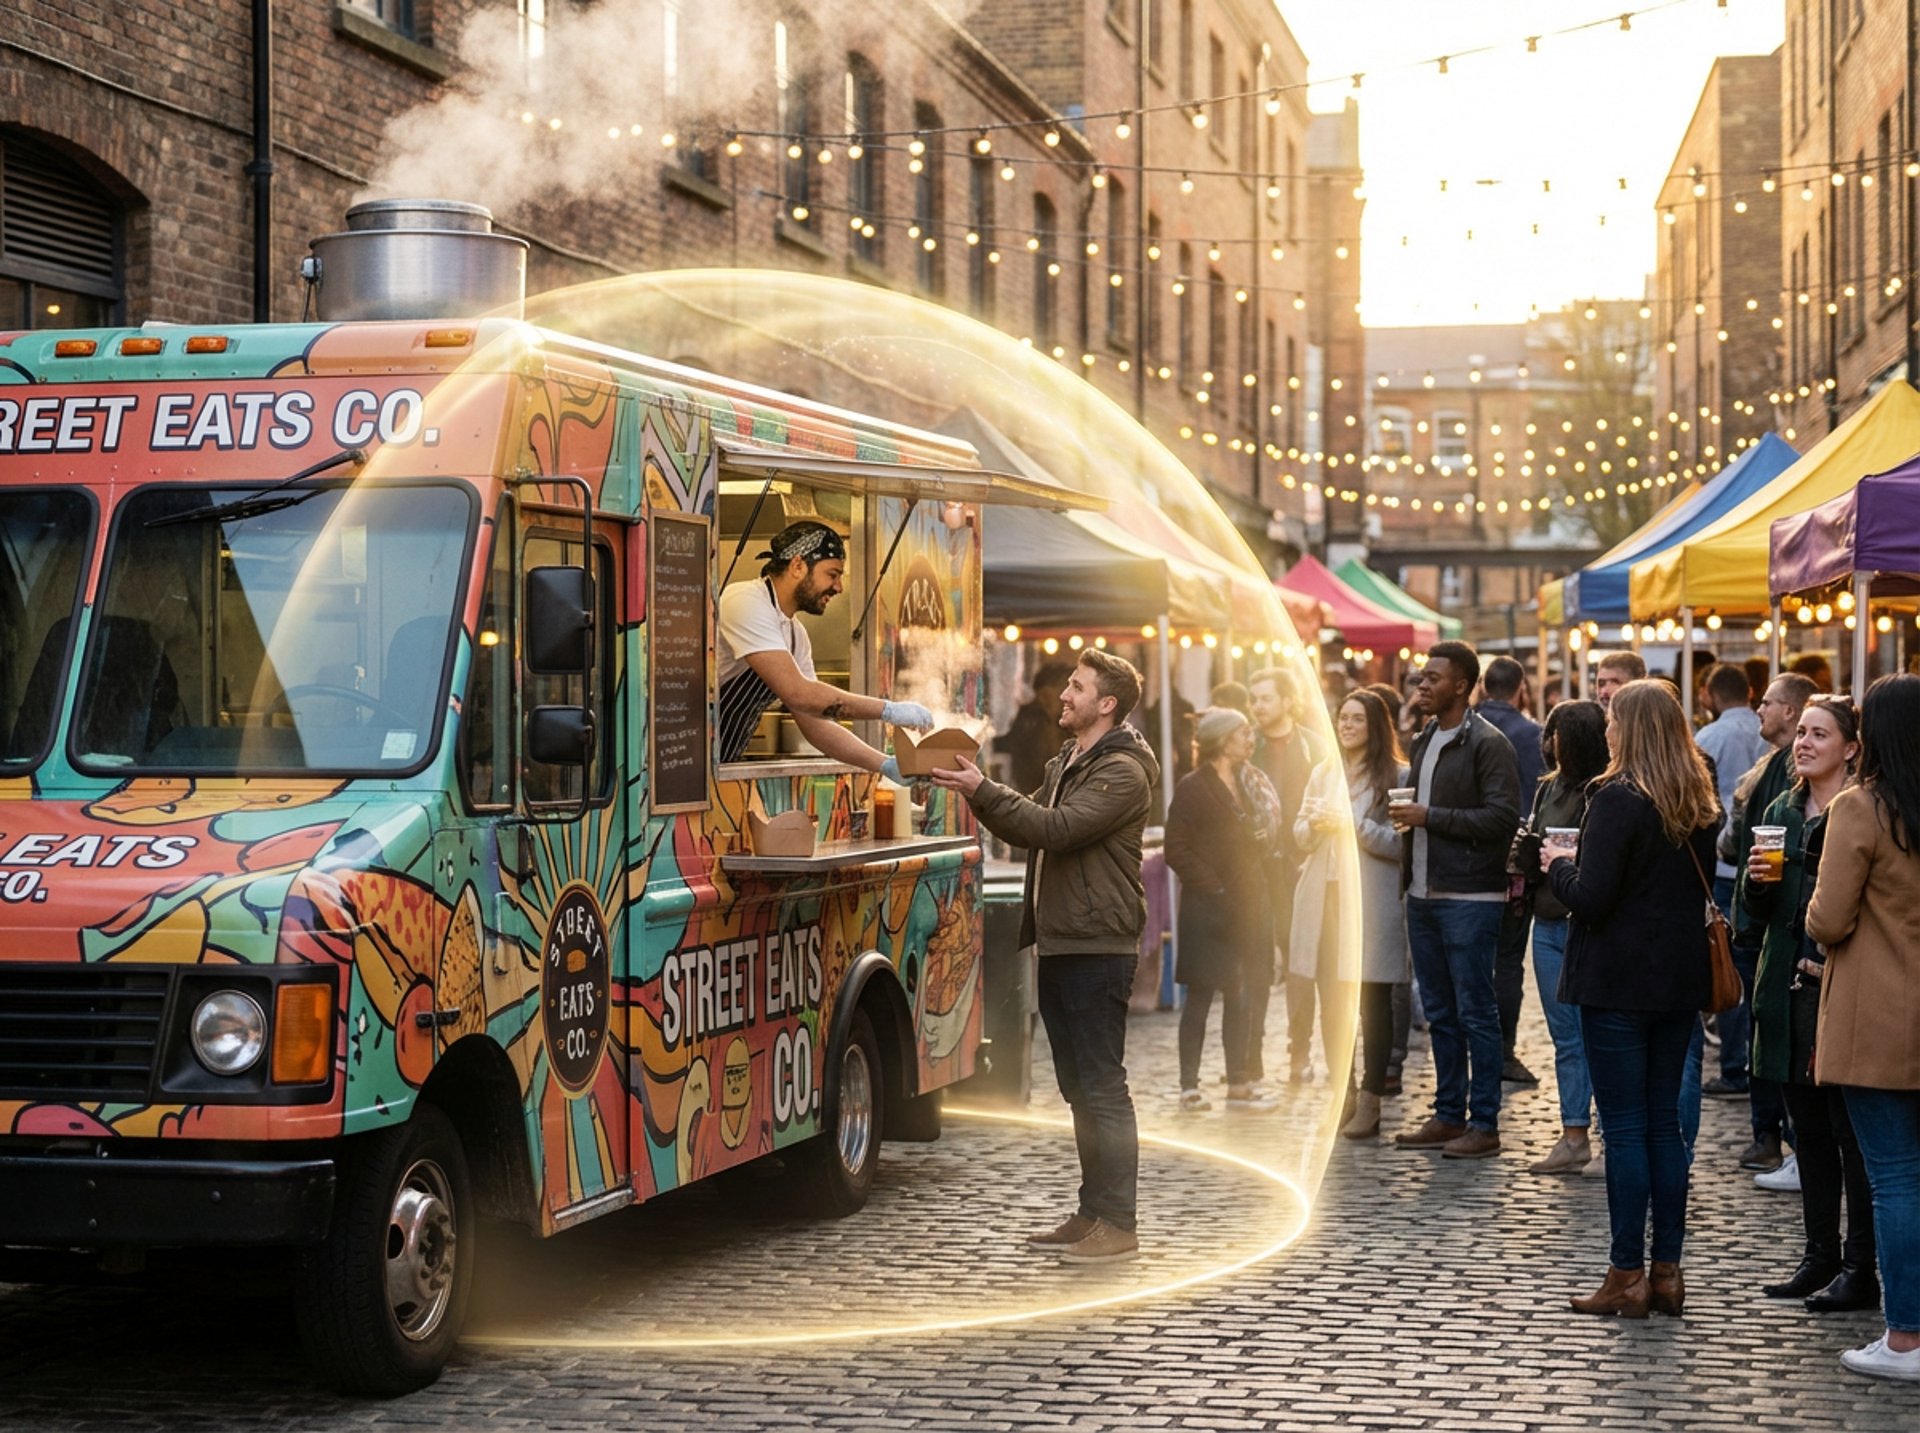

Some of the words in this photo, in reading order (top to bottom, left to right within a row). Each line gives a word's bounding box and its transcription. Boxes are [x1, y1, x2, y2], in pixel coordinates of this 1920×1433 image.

[149, 391, 313, 450] EATS
[333, 389, 440, 448] CO.
[0, 834, 198, 867] EATS
[560, 981, 594, 1021] EATS
[662, 938, 759, 1044] STREET
[765, 924, 823, 1016] EATS
[567, 1027, 590, 1060] CO.
[773, 1027, 819, 1122] CO.
